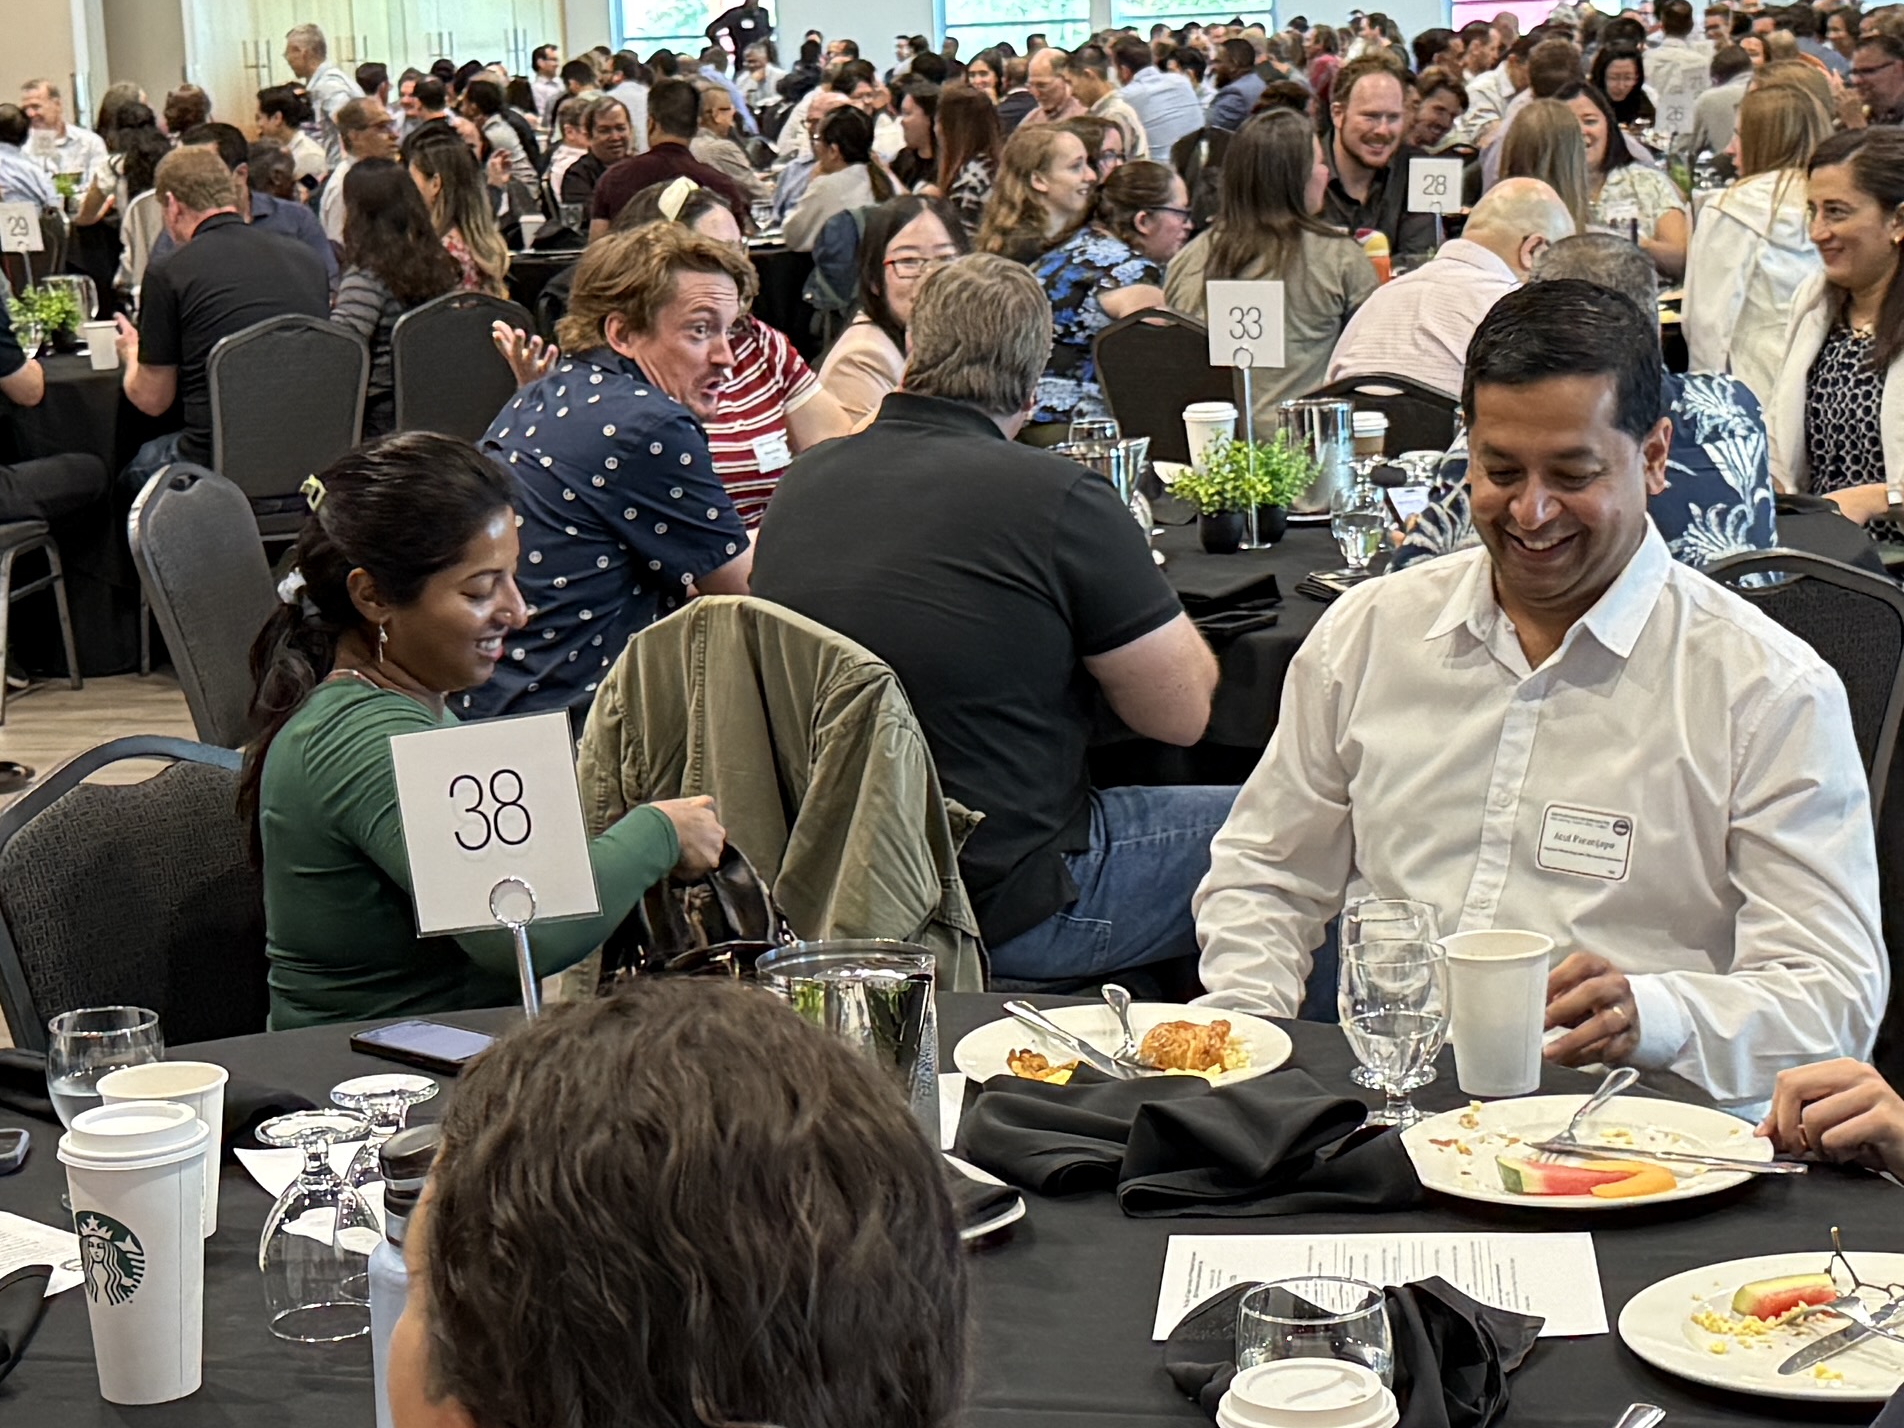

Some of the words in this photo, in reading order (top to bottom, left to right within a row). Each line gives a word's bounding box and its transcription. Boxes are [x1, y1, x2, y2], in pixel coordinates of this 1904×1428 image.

[1422, 174, 1447, 196] 28
[7, 215, 30, 237] 29
[1229, 306, 1263, 340] 33
[449, 768, 532, 851] 38
